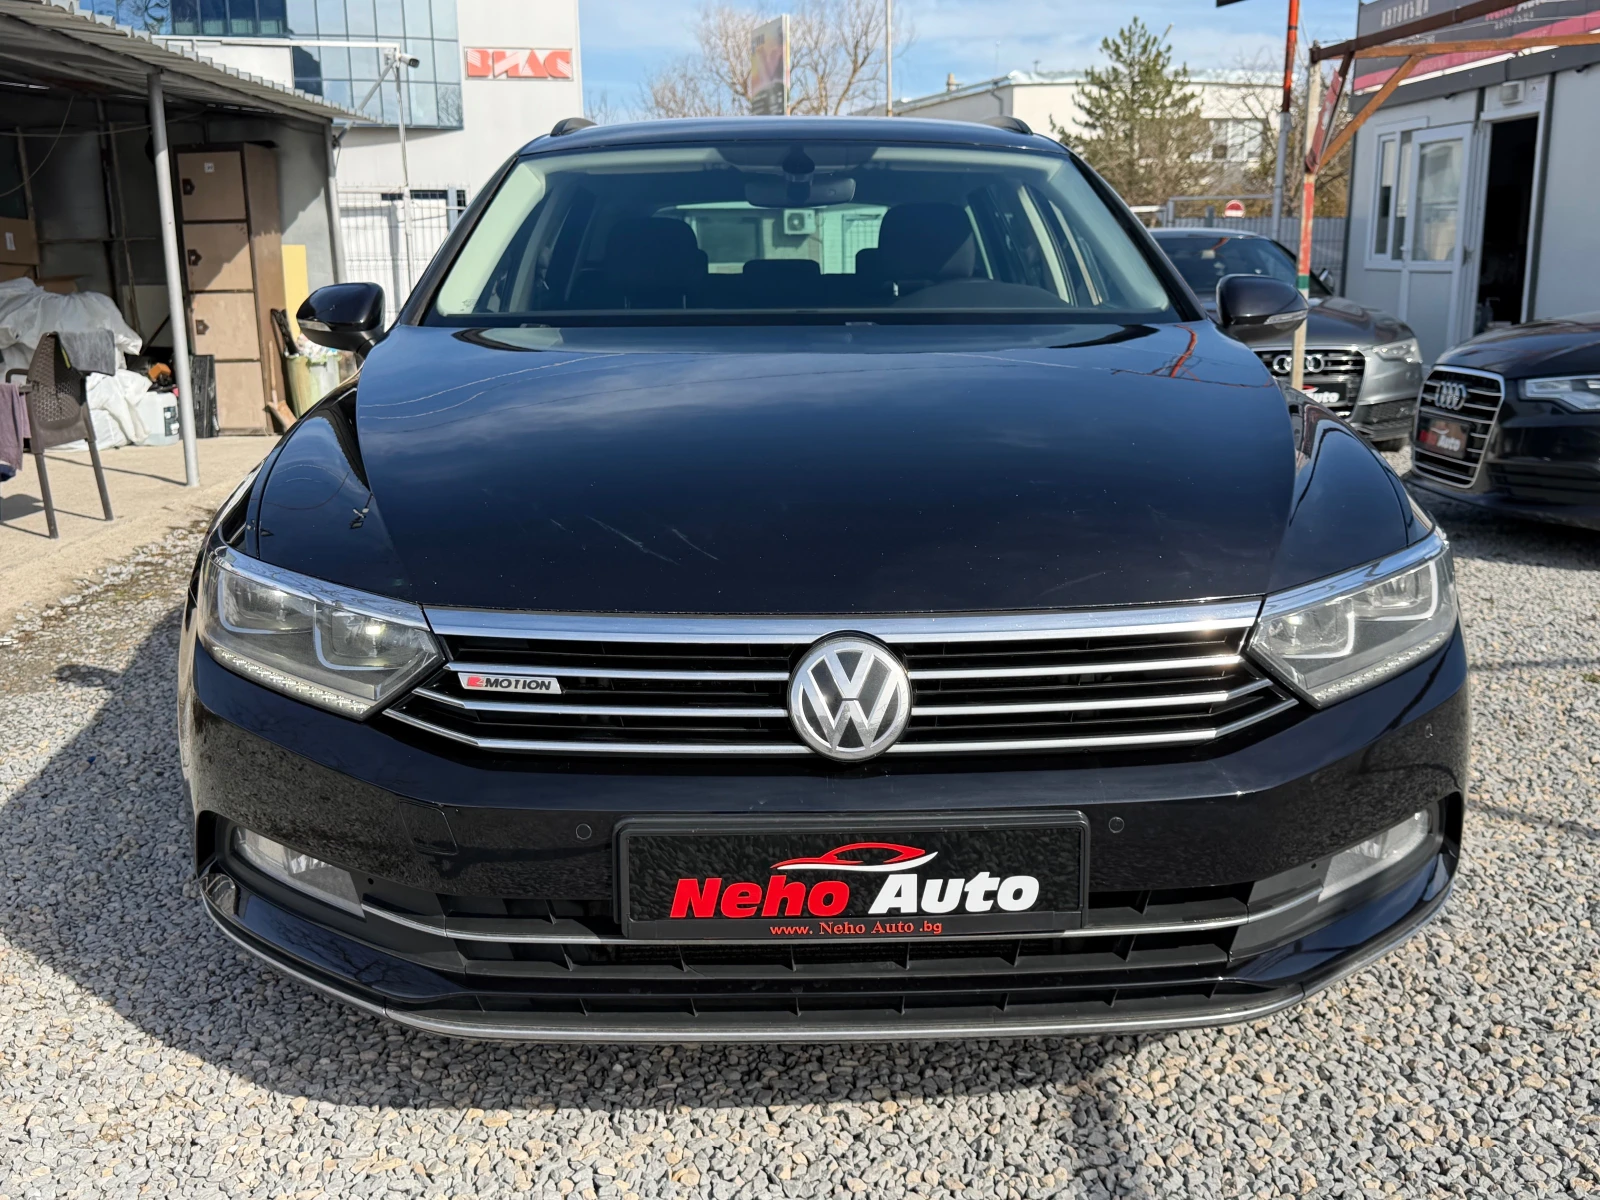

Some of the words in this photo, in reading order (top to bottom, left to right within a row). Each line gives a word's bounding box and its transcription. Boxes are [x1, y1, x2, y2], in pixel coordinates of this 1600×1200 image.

[669, 875, 850, 918] Neho
[868, 871, 1040, 915] Auto
[770, 925, 813, 935] www.
[819, 921, 866, 935] Neho
[870, 920, 914, 934] Auto
[919, 920, 943, 934] .bg
